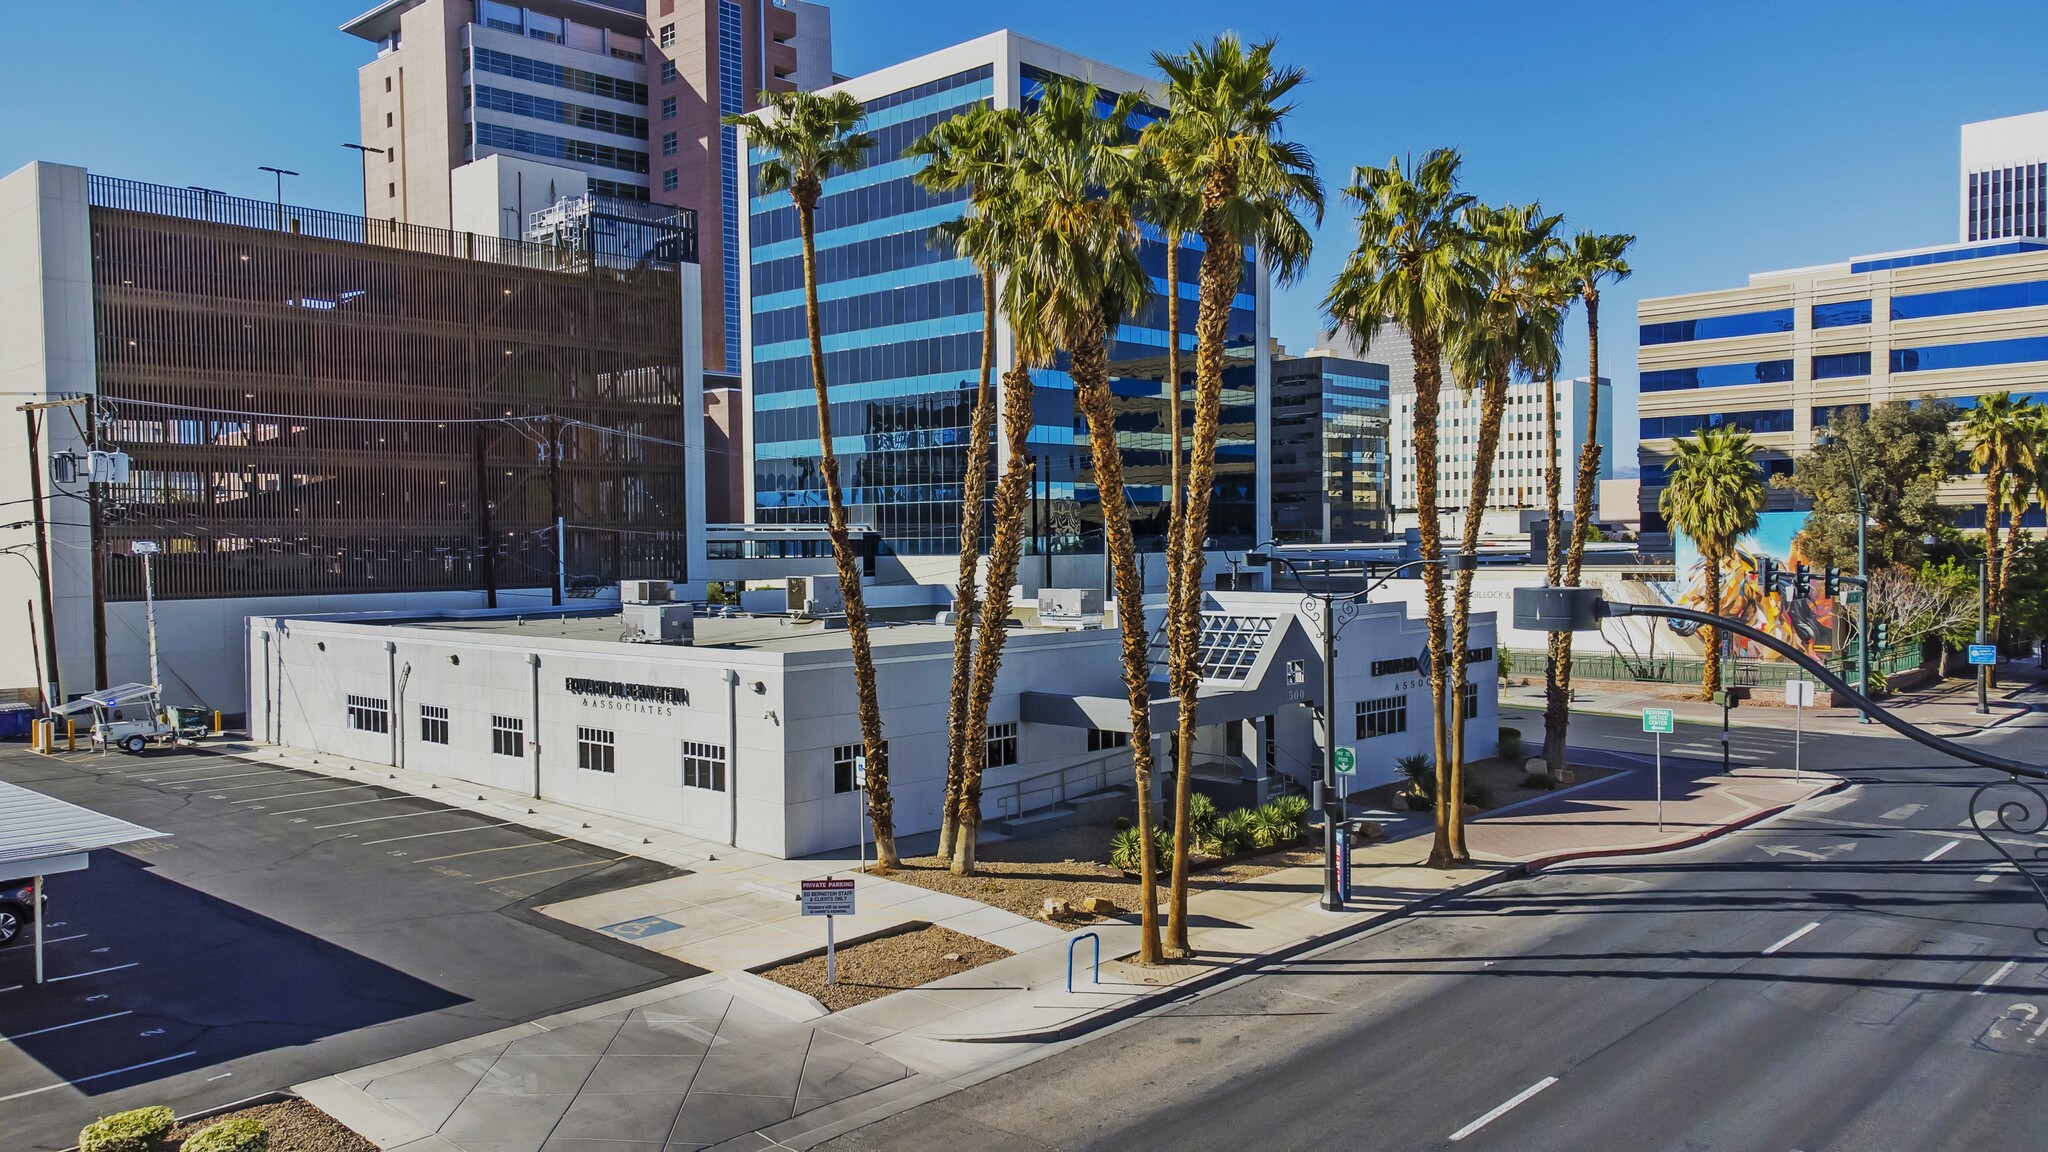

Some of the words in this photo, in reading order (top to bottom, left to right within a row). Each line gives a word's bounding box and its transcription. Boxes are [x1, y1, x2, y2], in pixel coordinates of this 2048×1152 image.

[1472, 591, 1504, 599] GILLOCK
[1371, 656, 1418, 677] EDWARD
[565, 677, 609, 696] EDWARD
[625, 683, 689, 706] BERNSTEIN
[1288, 689, 1305, 700] 500
[582, 698, 588, 706] &
[592, 700, 672, 716] ASSOCIATES
